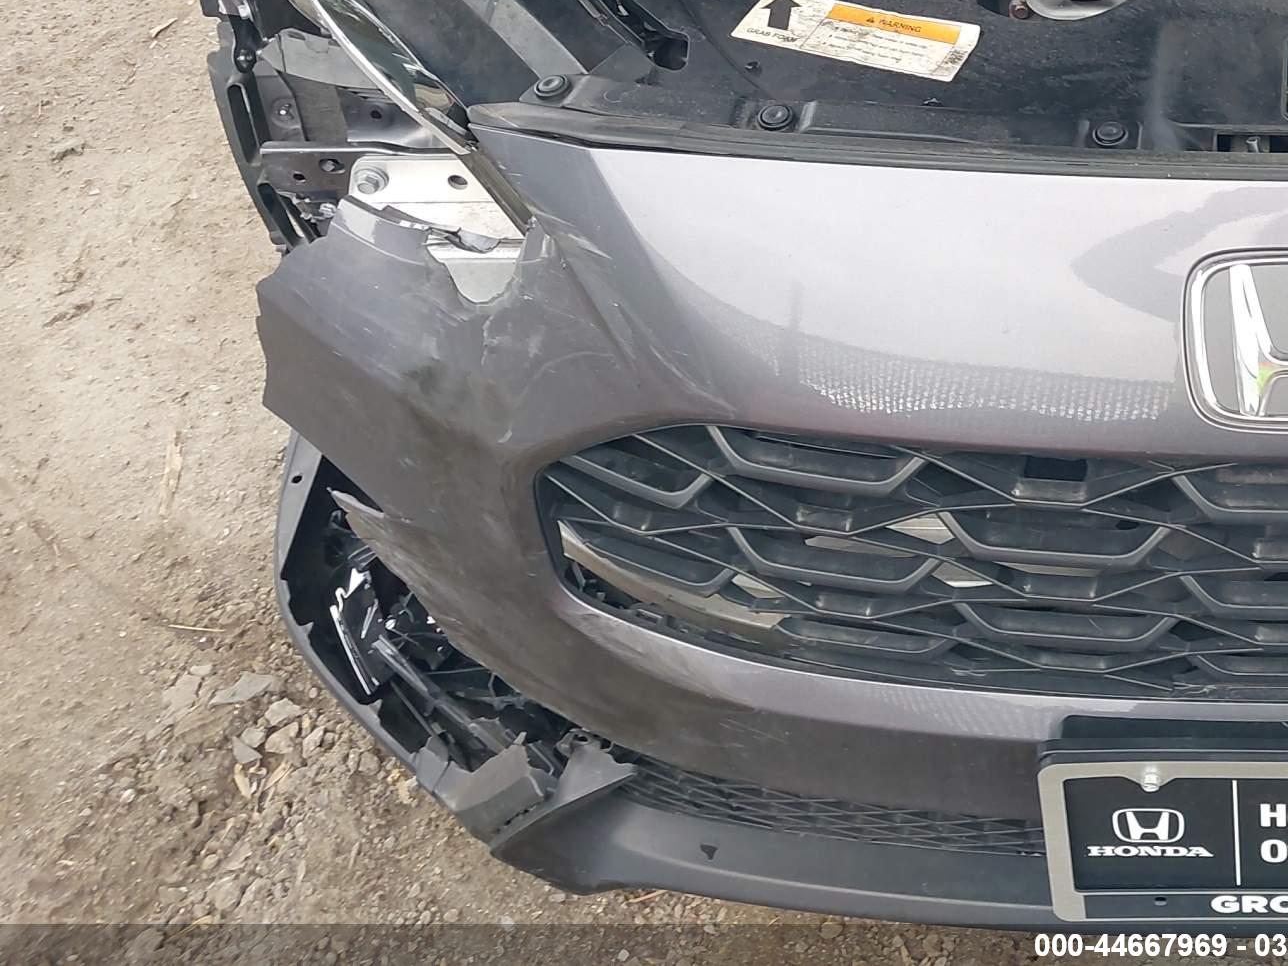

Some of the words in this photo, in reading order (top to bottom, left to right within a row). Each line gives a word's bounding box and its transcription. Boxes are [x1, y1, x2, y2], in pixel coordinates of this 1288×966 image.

[746, 27, 771, 37] GRAB
[878, 18, 922, 33] WARNING
[1086, 845, 1214, 858] HONDA
